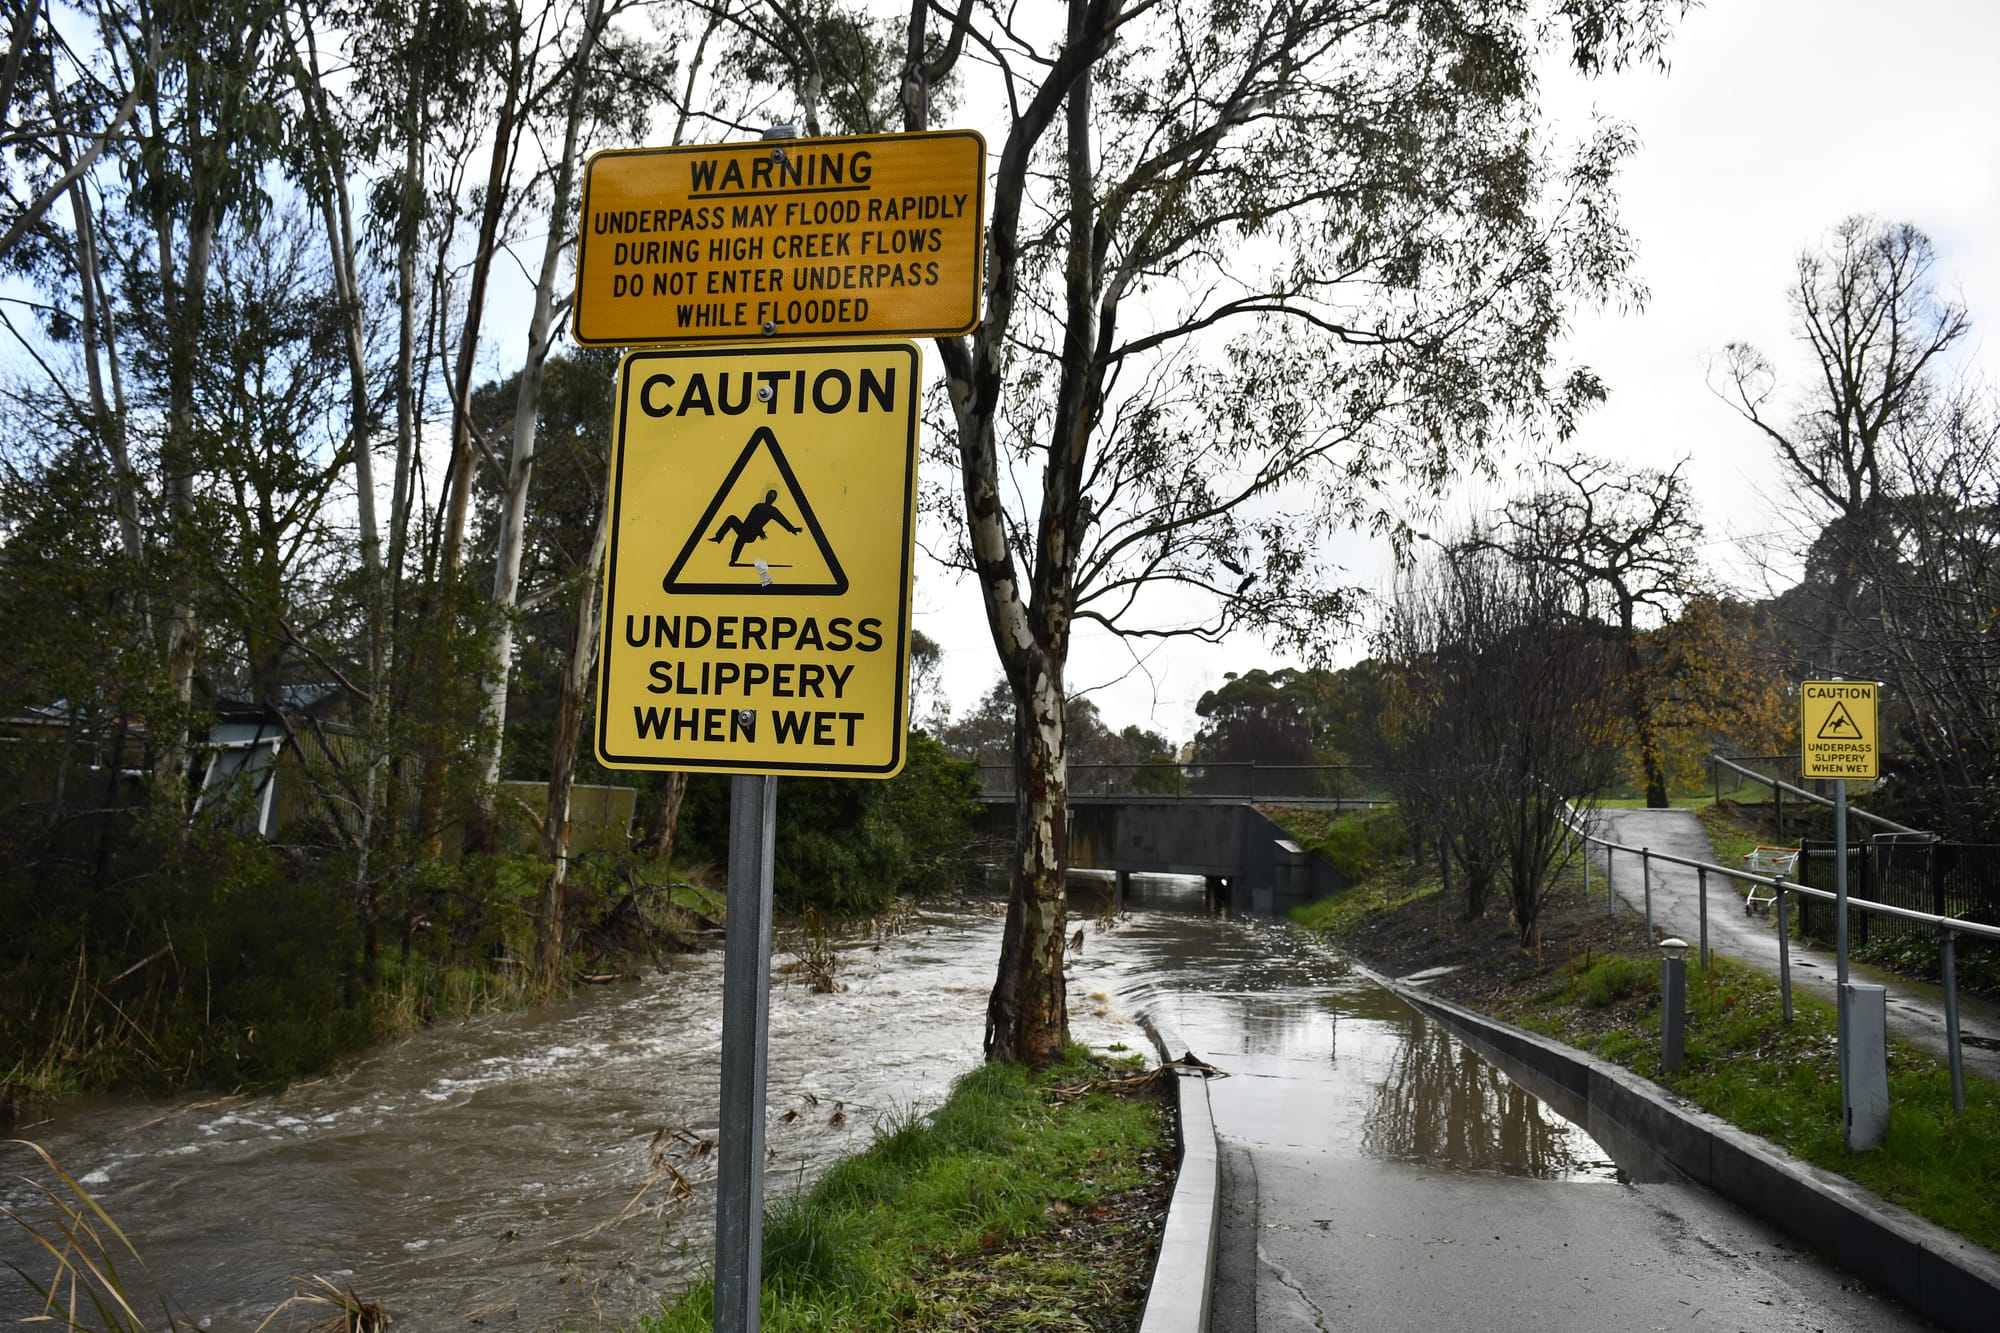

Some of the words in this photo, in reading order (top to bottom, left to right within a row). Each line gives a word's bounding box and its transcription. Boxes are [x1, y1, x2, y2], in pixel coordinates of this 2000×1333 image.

[691, 151, 873, 192] WARNING
[595, 206, 724, 235] UNDERPASS
[732, 204, 777, 229] MAY
[785, 200, 860, 226] FLOOD
[868, 194, 968, 221] RAPIDLY
[614, 239, 699, 266] DURING
[709, 237, 763, 262] HIGH
[773, 233, 850, 258] CREEK
[861, 228, 942, 255] FLOWS
[614, 273, 644, 298] DO
[653, 271, 698, 295] NOT
[707, 268, 784, 294] ENTER
[793, 261, 939, 290] UNDERPASS
[676, 302, 747, 328] WHILE
[757, 298, 869, 325] FLOODED
[640, 367, 896, 418] CAUTION
[626, 615, 883, 651] UNDERPASS
[647, 661, 855, 699] SLIPPERY
[1807, 687, 1871, 699] CAUTION
[633, 706, 757, 743] WHEN
[772, 710, 865, 747] WET
[1808, 743, 1872, 752] UNDERPASS
[1815, 754, 1865, 762] SLIPPERY
[1811, 764, 1843, 772] WHEN
[1846, 764, 1869, 773] WET
